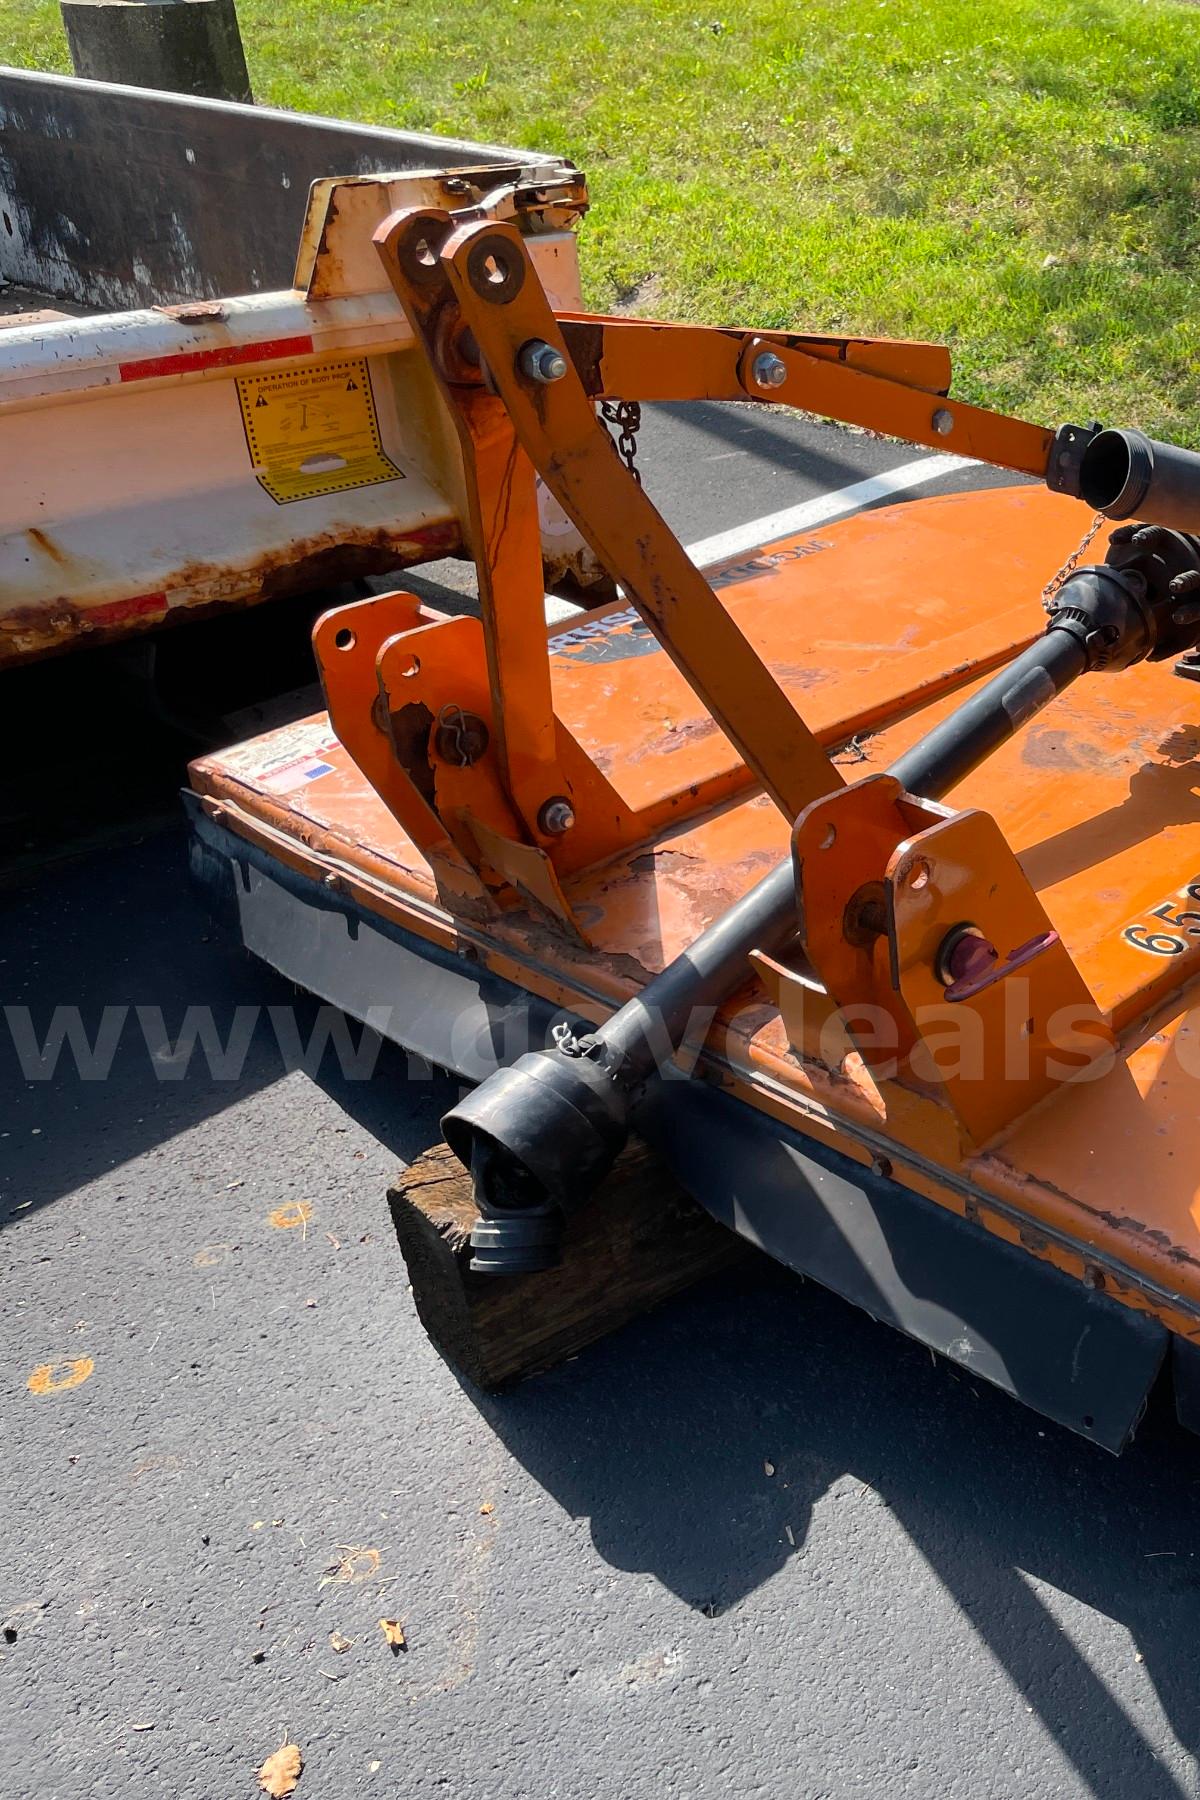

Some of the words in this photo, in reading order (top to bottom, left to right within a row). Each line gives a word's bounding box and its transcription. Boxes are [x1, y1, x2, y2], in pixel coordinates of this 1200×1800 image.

[257, 381, 298, 394] OPERATION
[311, 375, 330, 384] BODY
[332, 371, 351, 380] PROP
